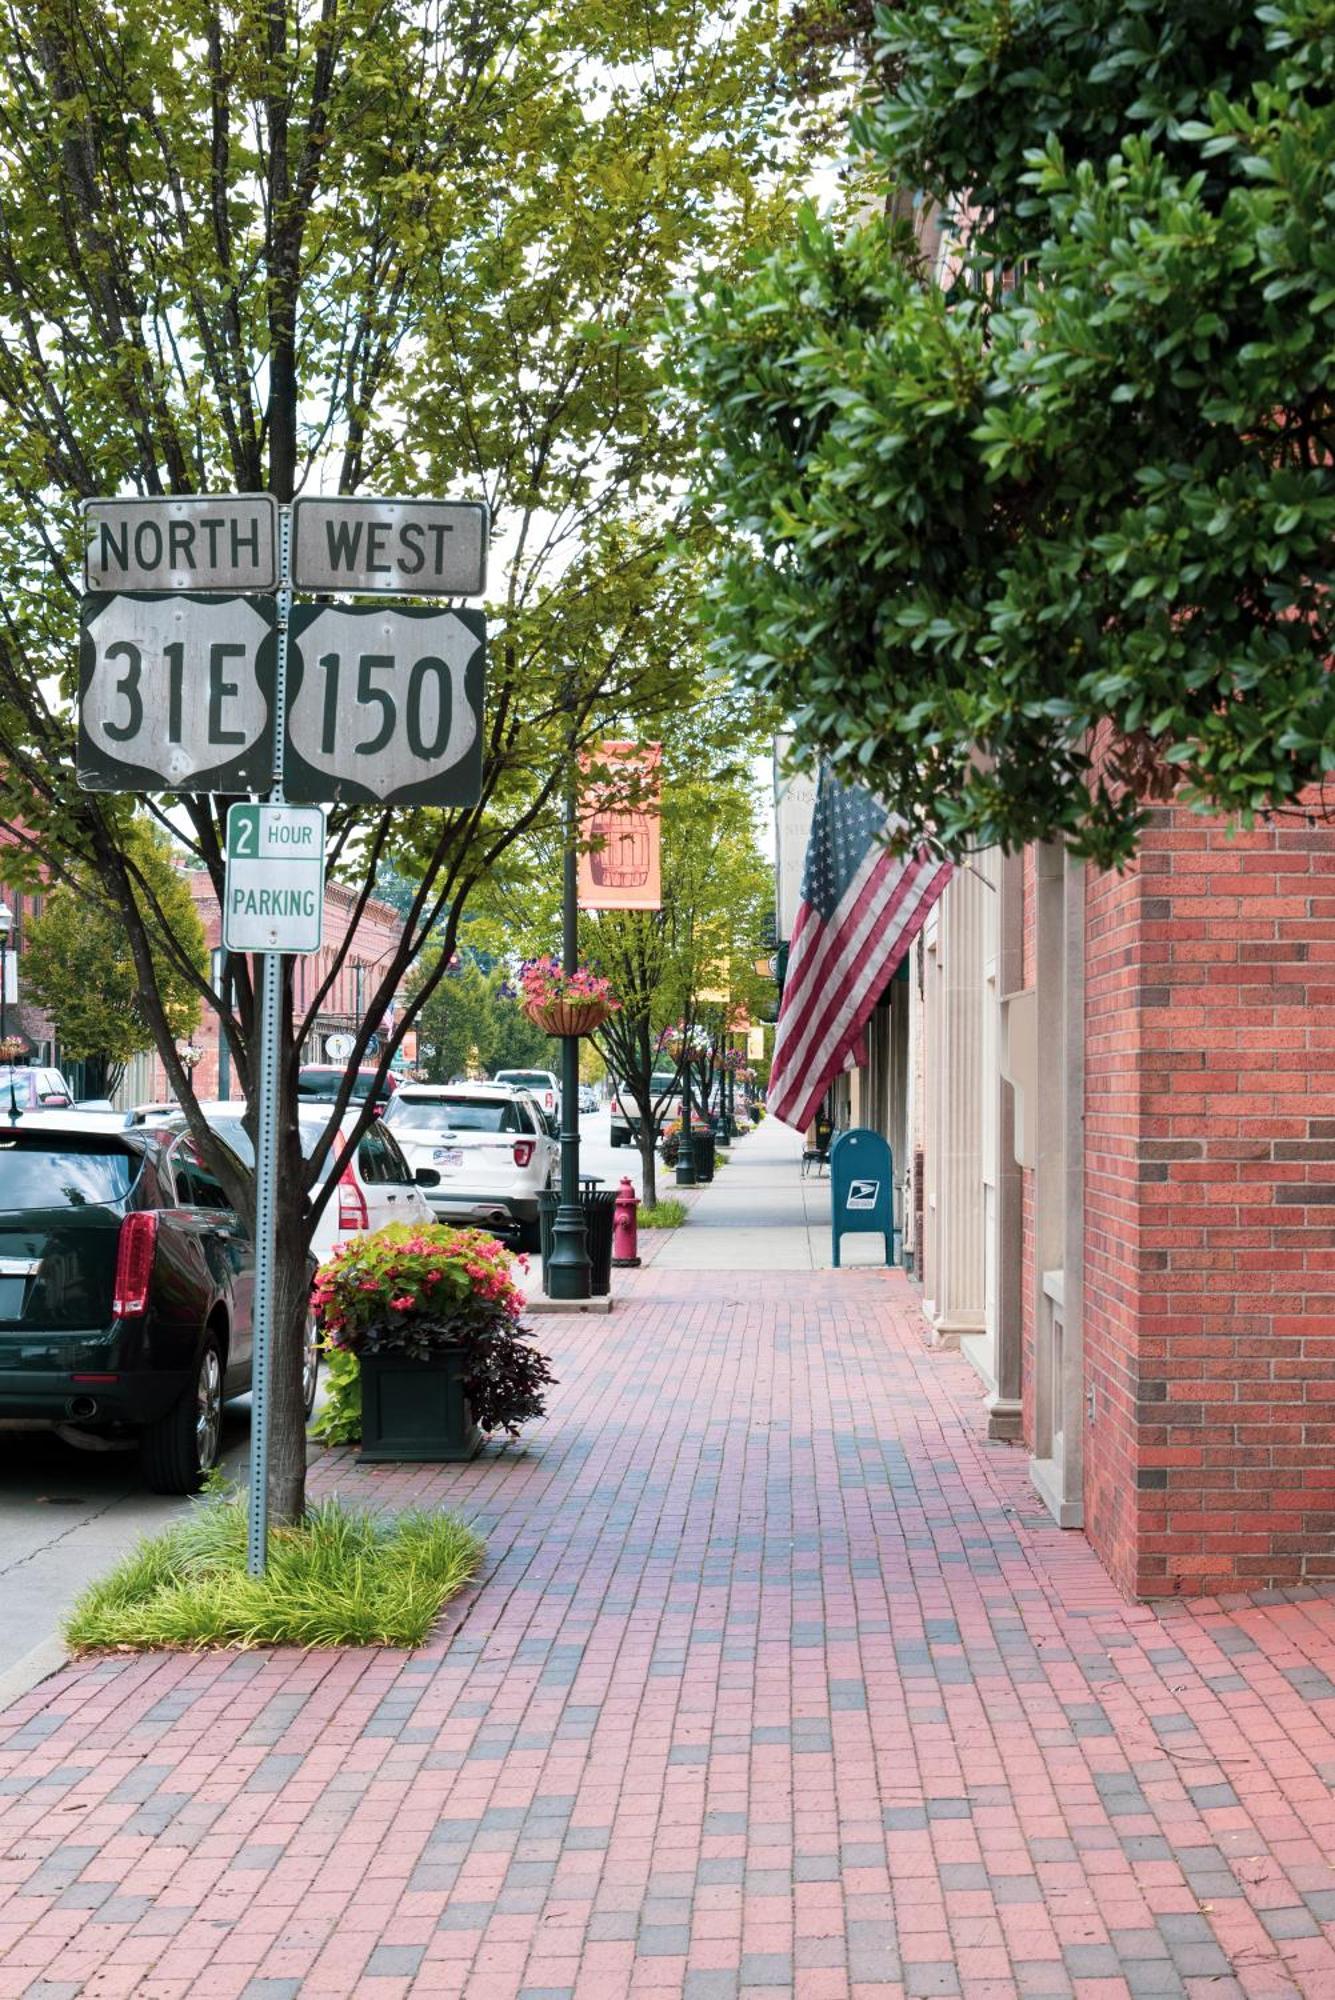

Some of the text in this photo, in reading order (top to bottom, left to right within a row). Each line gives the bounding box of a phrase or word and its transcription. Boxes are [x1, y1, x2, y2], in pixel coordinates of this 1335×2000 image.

[100, 519, 260, 573] NORTH
[325, 518, 454, 576] WEST
[102, 641, 246, 746] 31E
[319, 653, 454, 759] 150
[235, 819, 312, 855] 2 HOUR
[232, 888, 315, 918] PARKING
